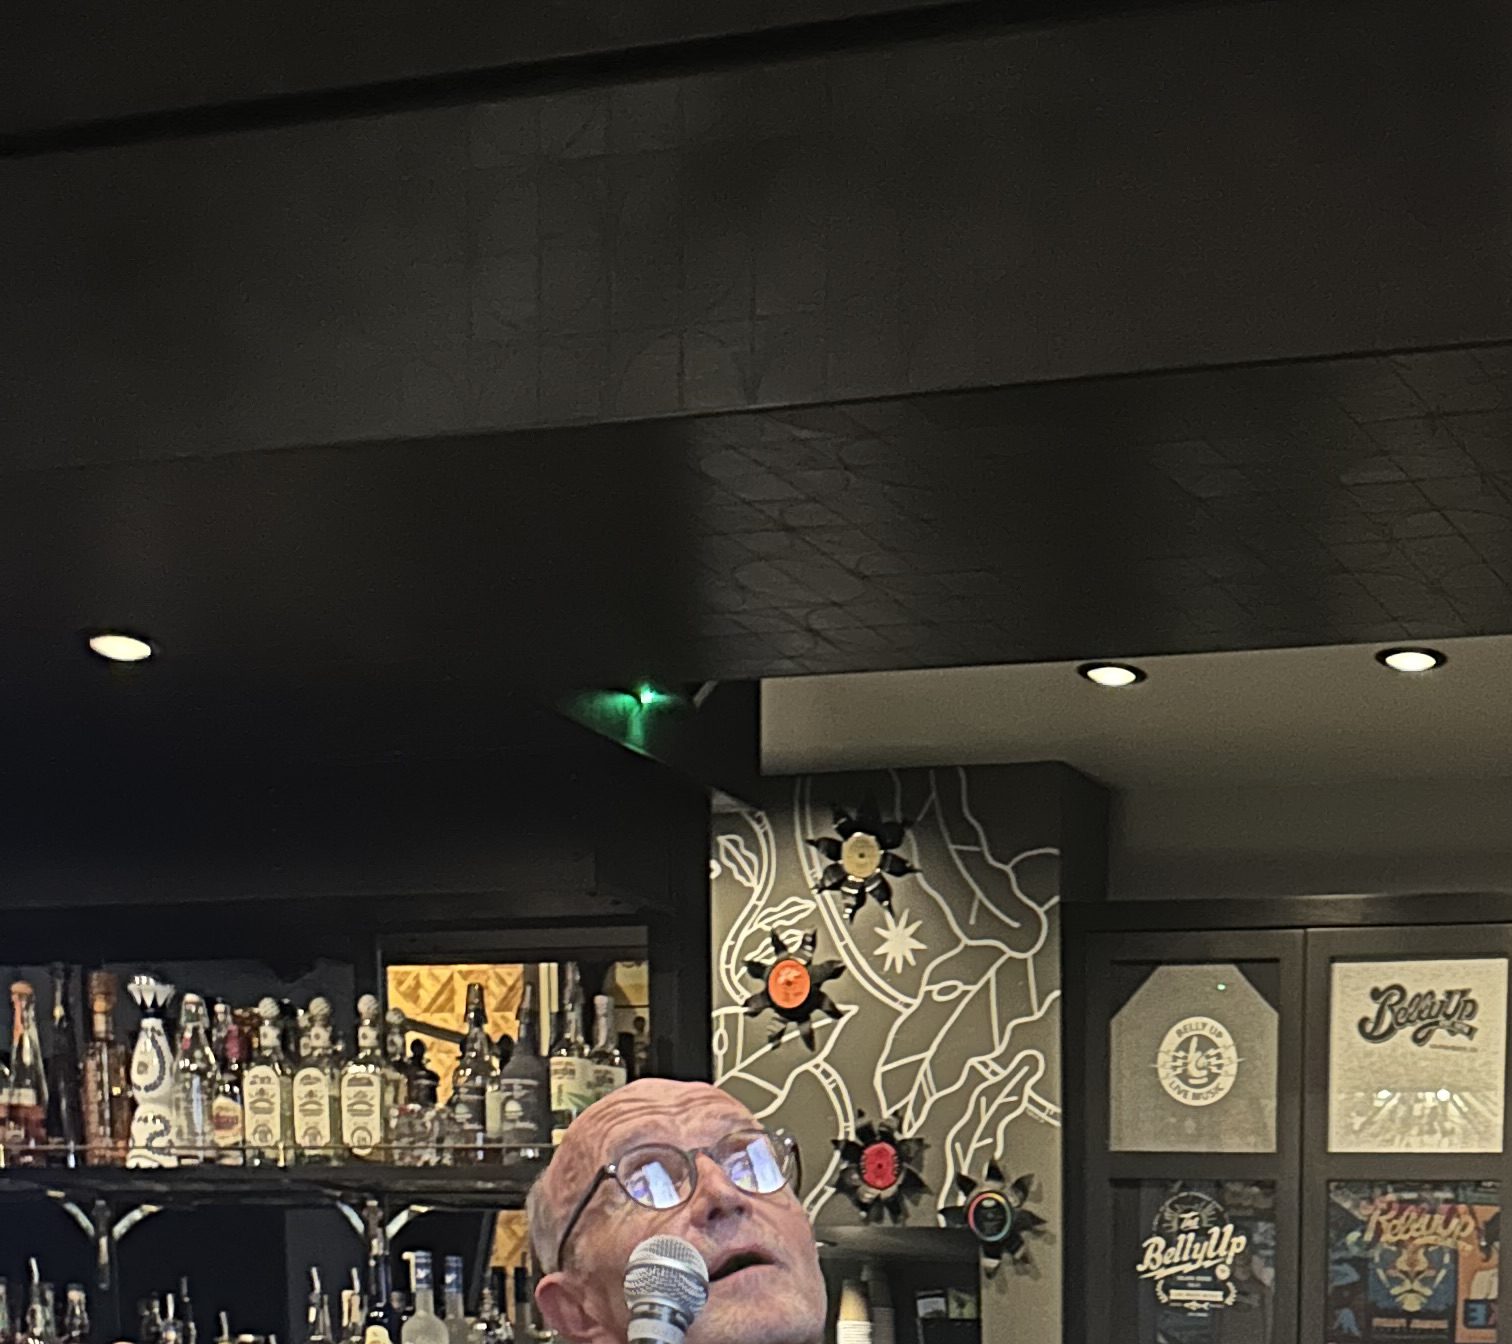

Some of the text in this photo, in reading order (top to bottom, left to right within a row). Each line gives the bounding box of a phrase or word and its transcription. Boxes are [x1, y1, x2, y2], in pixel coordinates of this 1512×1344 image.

[1176, 1021, 1224, 1039] BELLY UP
[1169, 1080, 1225, 1101] LIVE MUSIC
